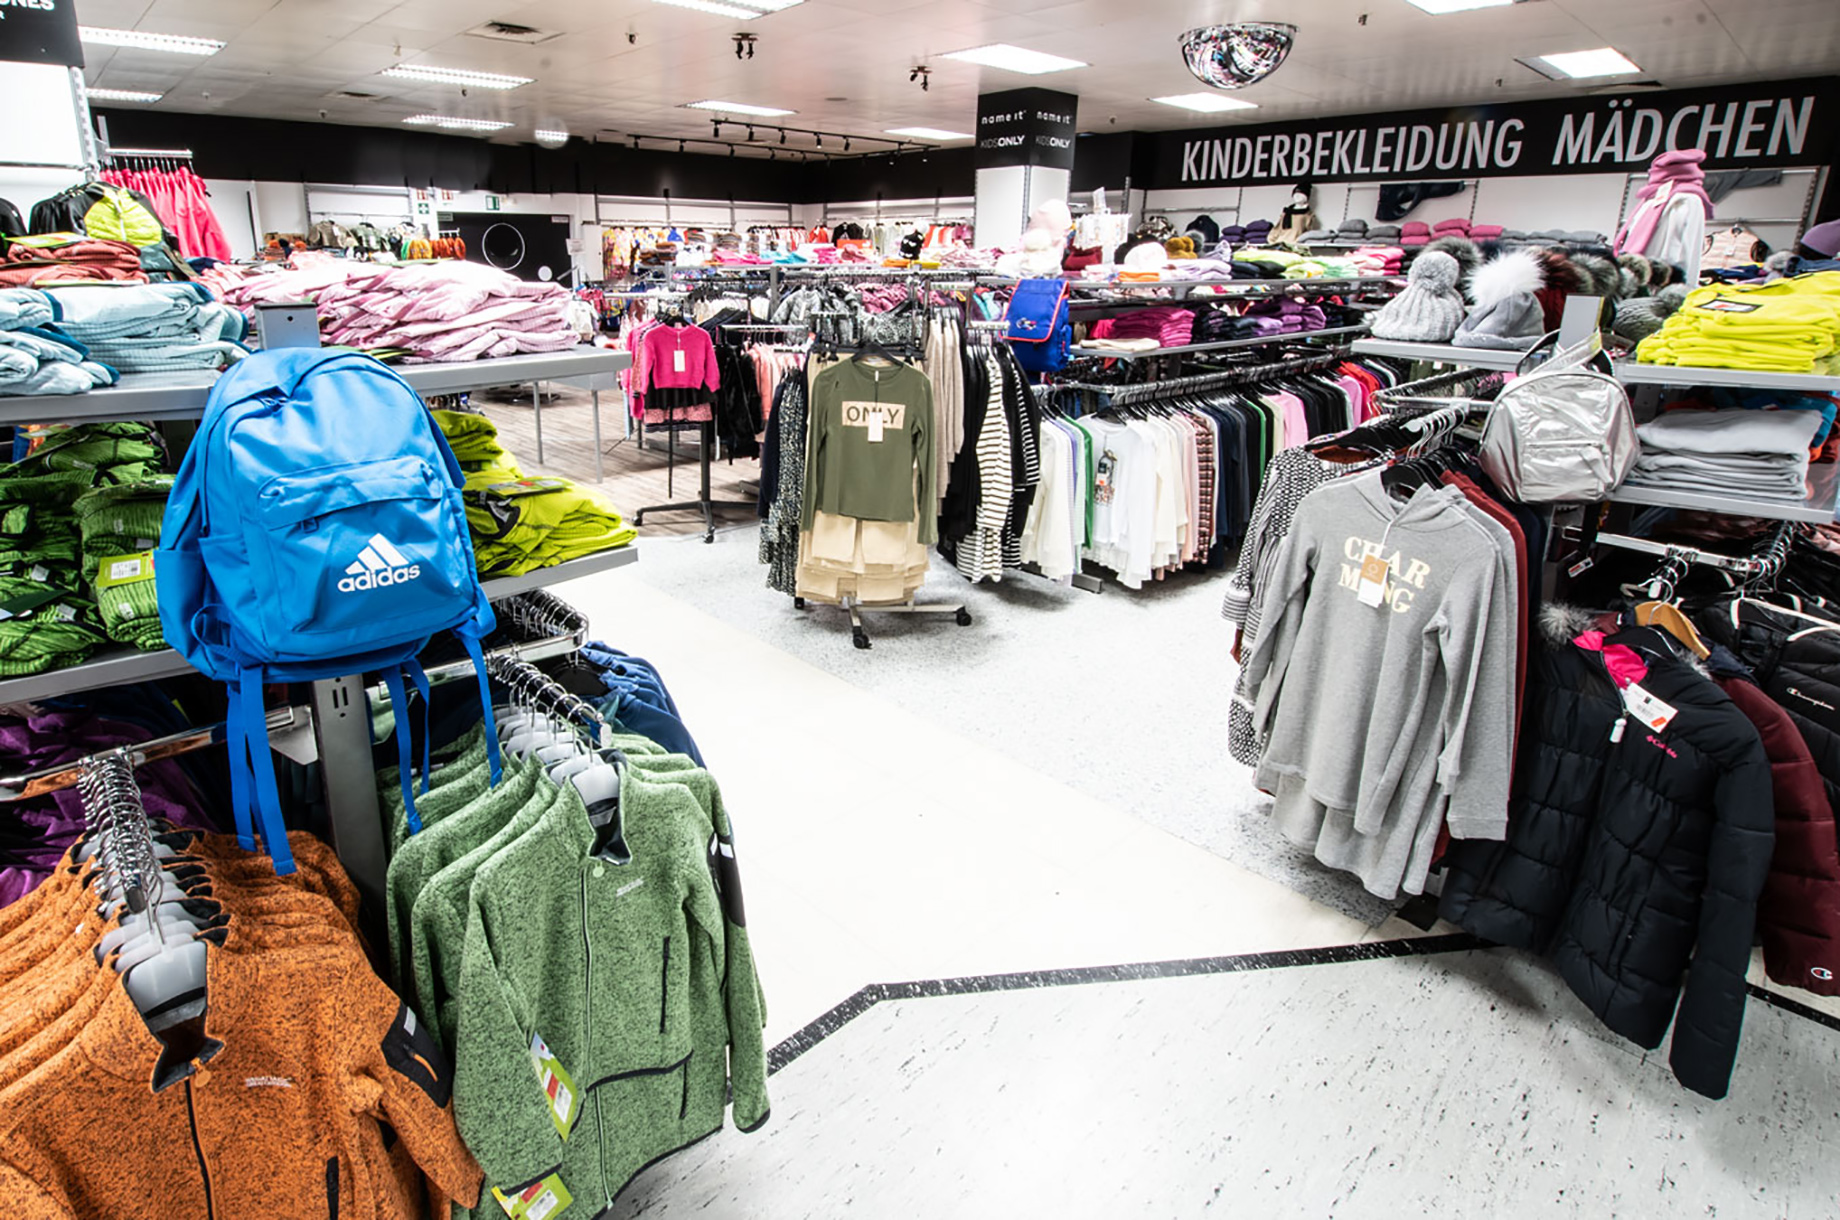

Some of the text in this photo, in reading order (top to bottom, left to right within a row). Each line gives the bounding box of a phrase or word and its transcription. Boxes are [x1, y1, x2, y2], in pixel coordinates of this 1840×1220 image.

[981, 113, 1012, 125] name
[1036, 111, 1061, 123] name
[1181, 96, 1815, 182] KINDERBEKLEIDUNG MÄDCHEN
[337, 564, 421, 592] adidas
